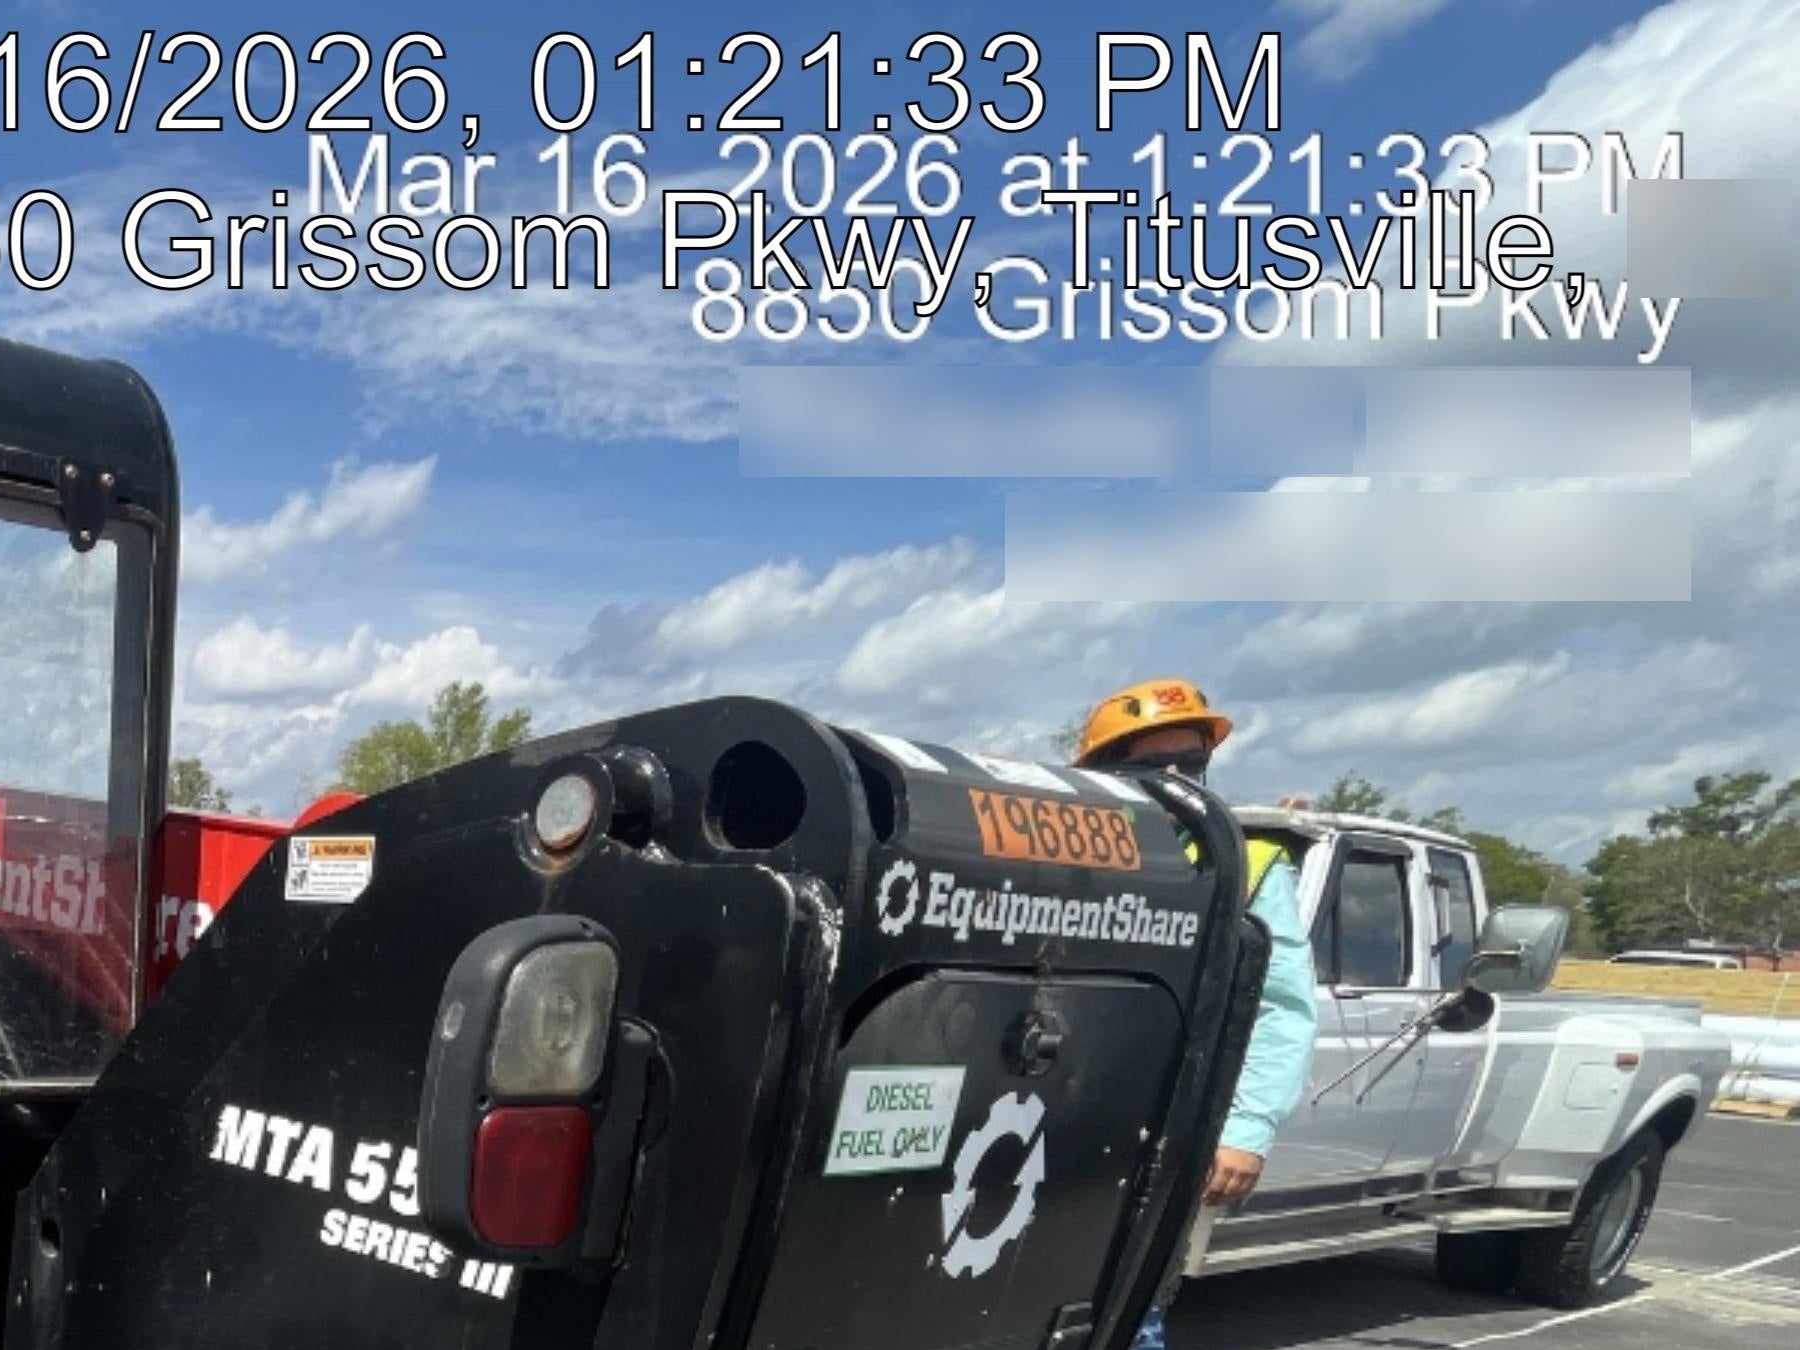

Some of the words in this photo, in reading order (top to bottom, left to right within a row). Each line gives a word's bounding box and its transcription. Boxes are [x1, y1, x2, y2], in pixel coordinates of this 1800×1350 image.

[976, 791, 1138, 868] 196888
[923, 871, 1199, 948] EquipmentShare
[865, 1082, 936, 1113] DIESEL
[209, 1104, 335, 1192] MTA
[836, 1128, 885, 1158] FUEL
[890, 1124, 946, 1158] ONLY
[320, 1208, 454, 1279] SERIES
[458, 1258, 515, 1300] III
